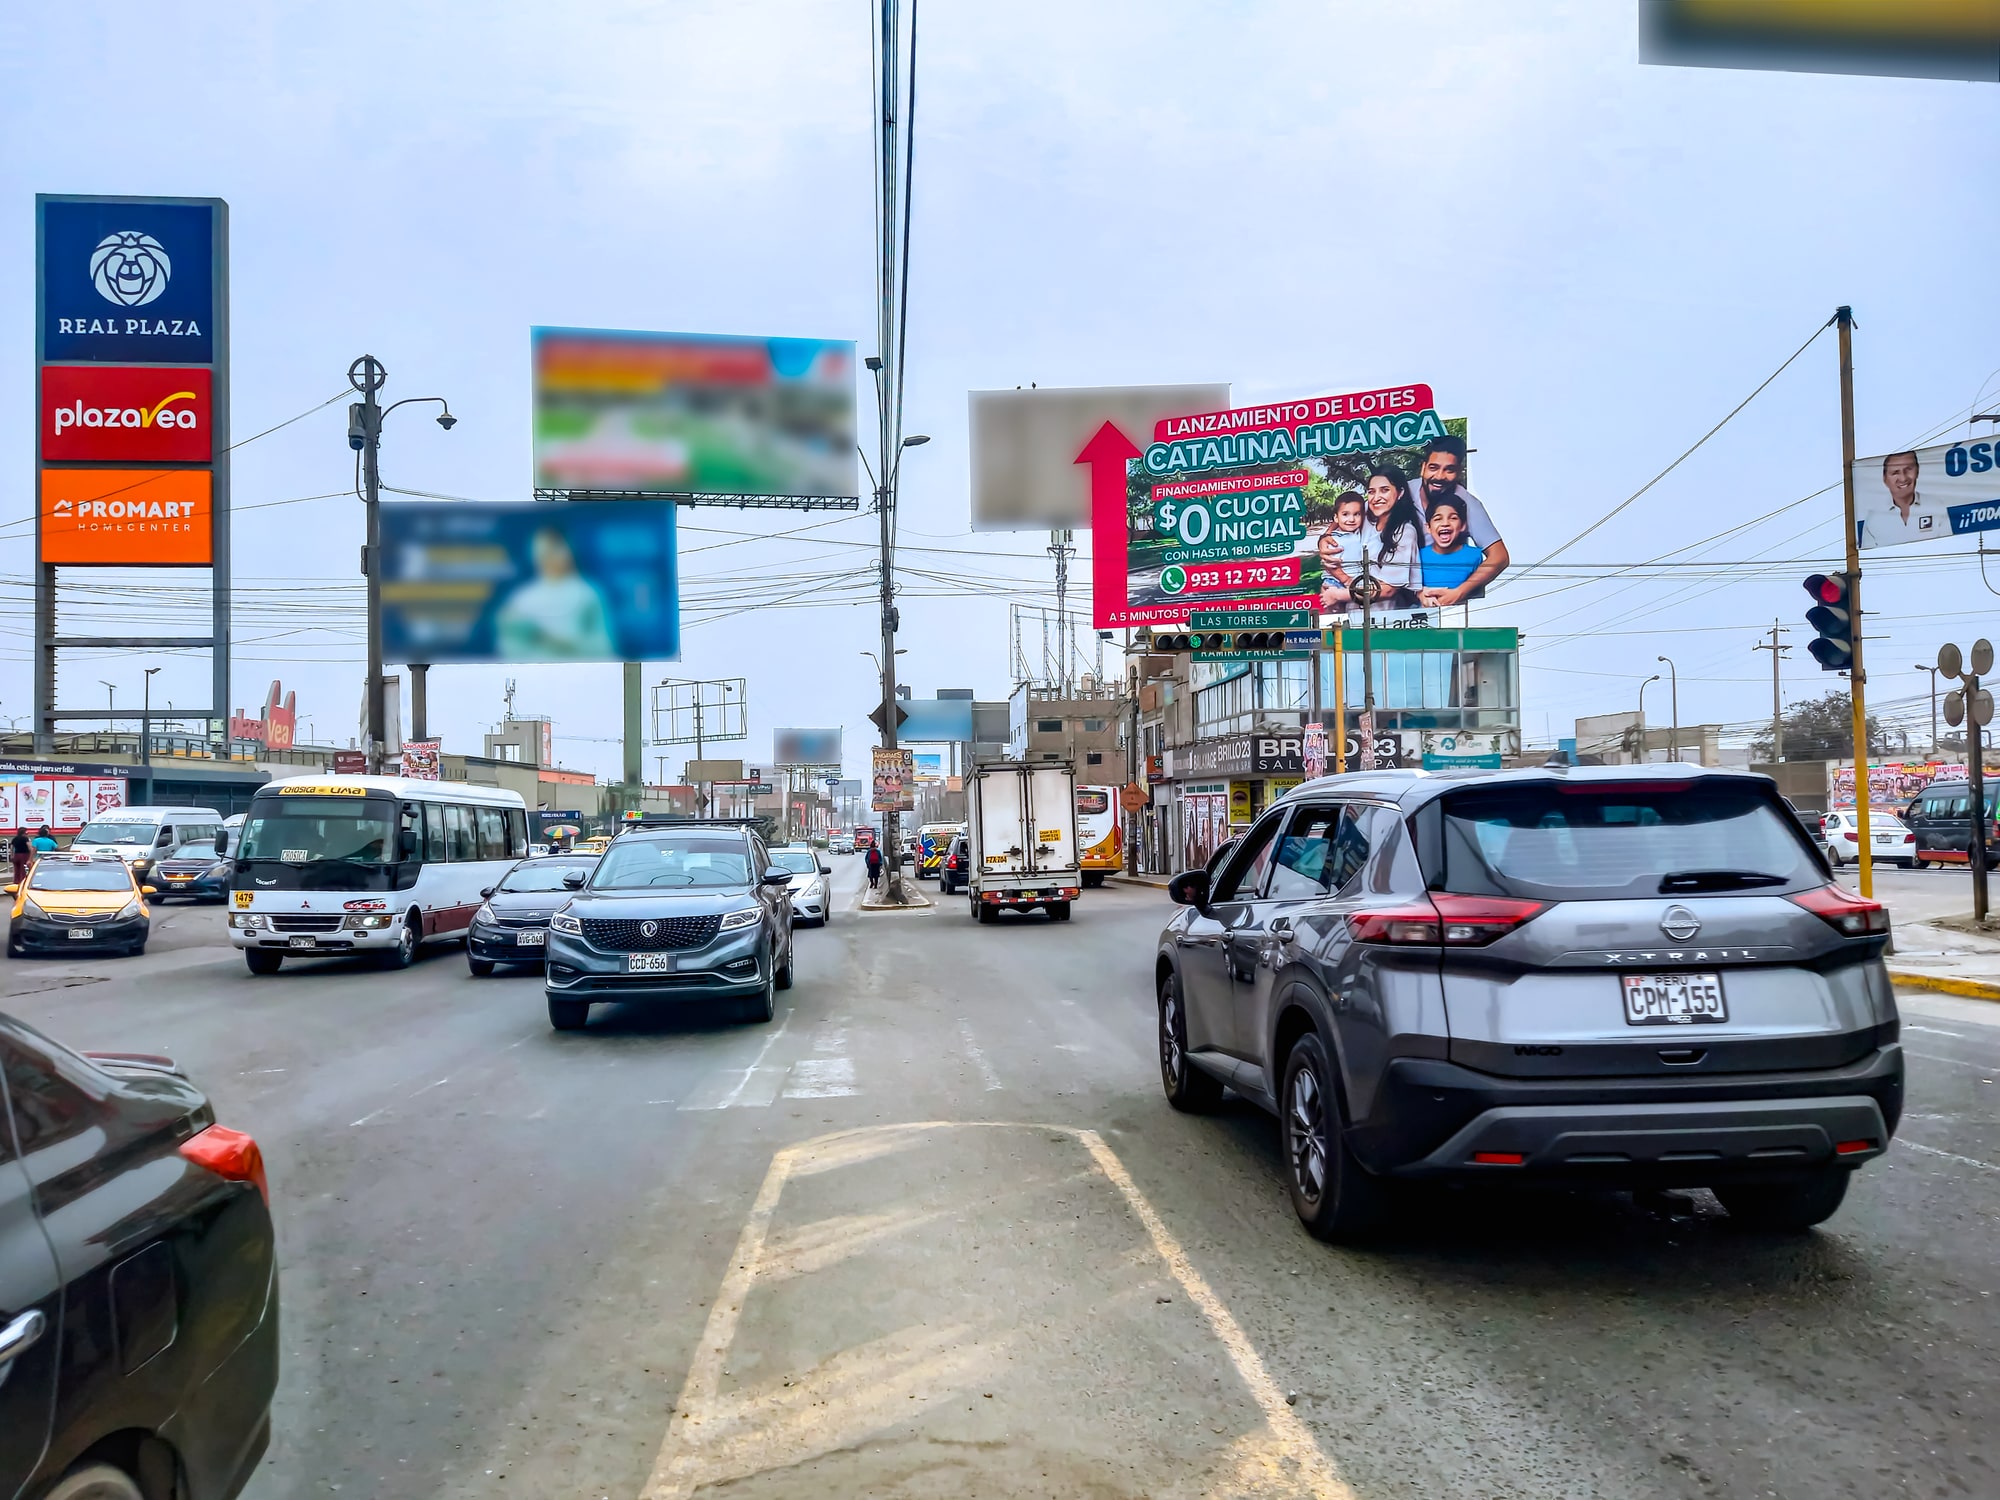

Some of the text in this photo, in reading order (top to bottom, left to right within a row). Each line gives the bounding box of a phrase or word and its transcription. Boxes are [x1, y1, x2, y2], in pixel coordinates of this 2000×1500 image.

[59, 318, 202, 337] REAL PLAZA
[1167, 389, 1416, 436] LANZAMIENTO DE LOTES
[1147, 414, 1441, 471] CATALINA HUANCA
[1945, 442, 2000, 477] ÓS
[1156, 473, 1304, 497] FINANCIAMIENTO DIRECTO
[78, 501, 195, 518] PROMART
[1215, 493, 1300, 518] CUOTA
[78, 523, 191, 532] HOMECENTER
[1159, 501, 1211, 545] $0
[1215, 518, 1301, 542] INICIAL
[1165, 542, 1291, 561] CON HASTA 180 MESES
[1191, 566, 1291, 587] 933 12 70 22
[1109, 612, 1117, 622] A
[1120, 612, 1126, 621] 5
[1129, 609, 1179, 621] MINUTOS
[1238, 600, 1311, 612] PURUCHUCO
[1200, 616, 1268, 626] LAS TORRES
[235, 893, 254, 902] 1479
[629, 958, 666, 969] CCD-656
[1605, 950, 1757, 964] X-TRAIL
[1655, 976, 1688, 986] PERU
[1629, 985, 1719, 1015] CPM-155
